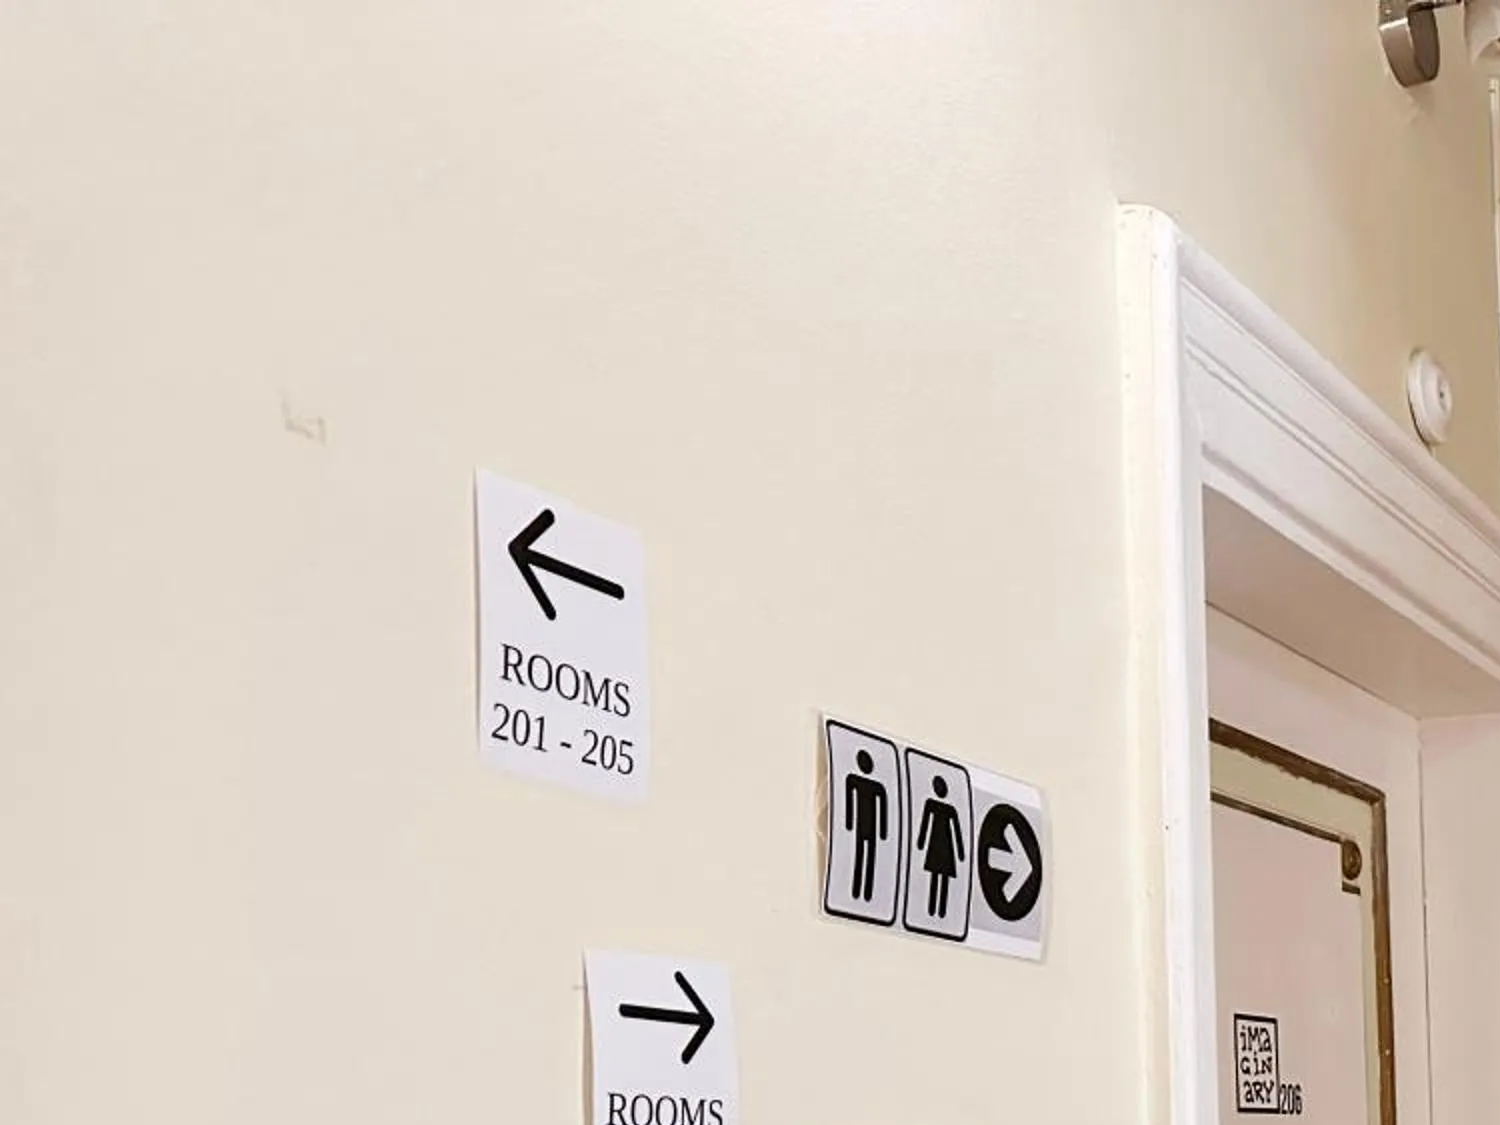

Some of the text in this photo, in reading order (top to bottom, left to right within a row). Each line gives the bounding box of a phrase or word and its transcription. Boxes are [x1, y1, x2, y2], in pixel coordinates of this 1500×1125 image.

[500, 643, 631, 718] ROOMS
[491, 702, 548, 753] 201
[581, 728, 634, 776] 205
[1280, 1083, 1303, 1115] 206
